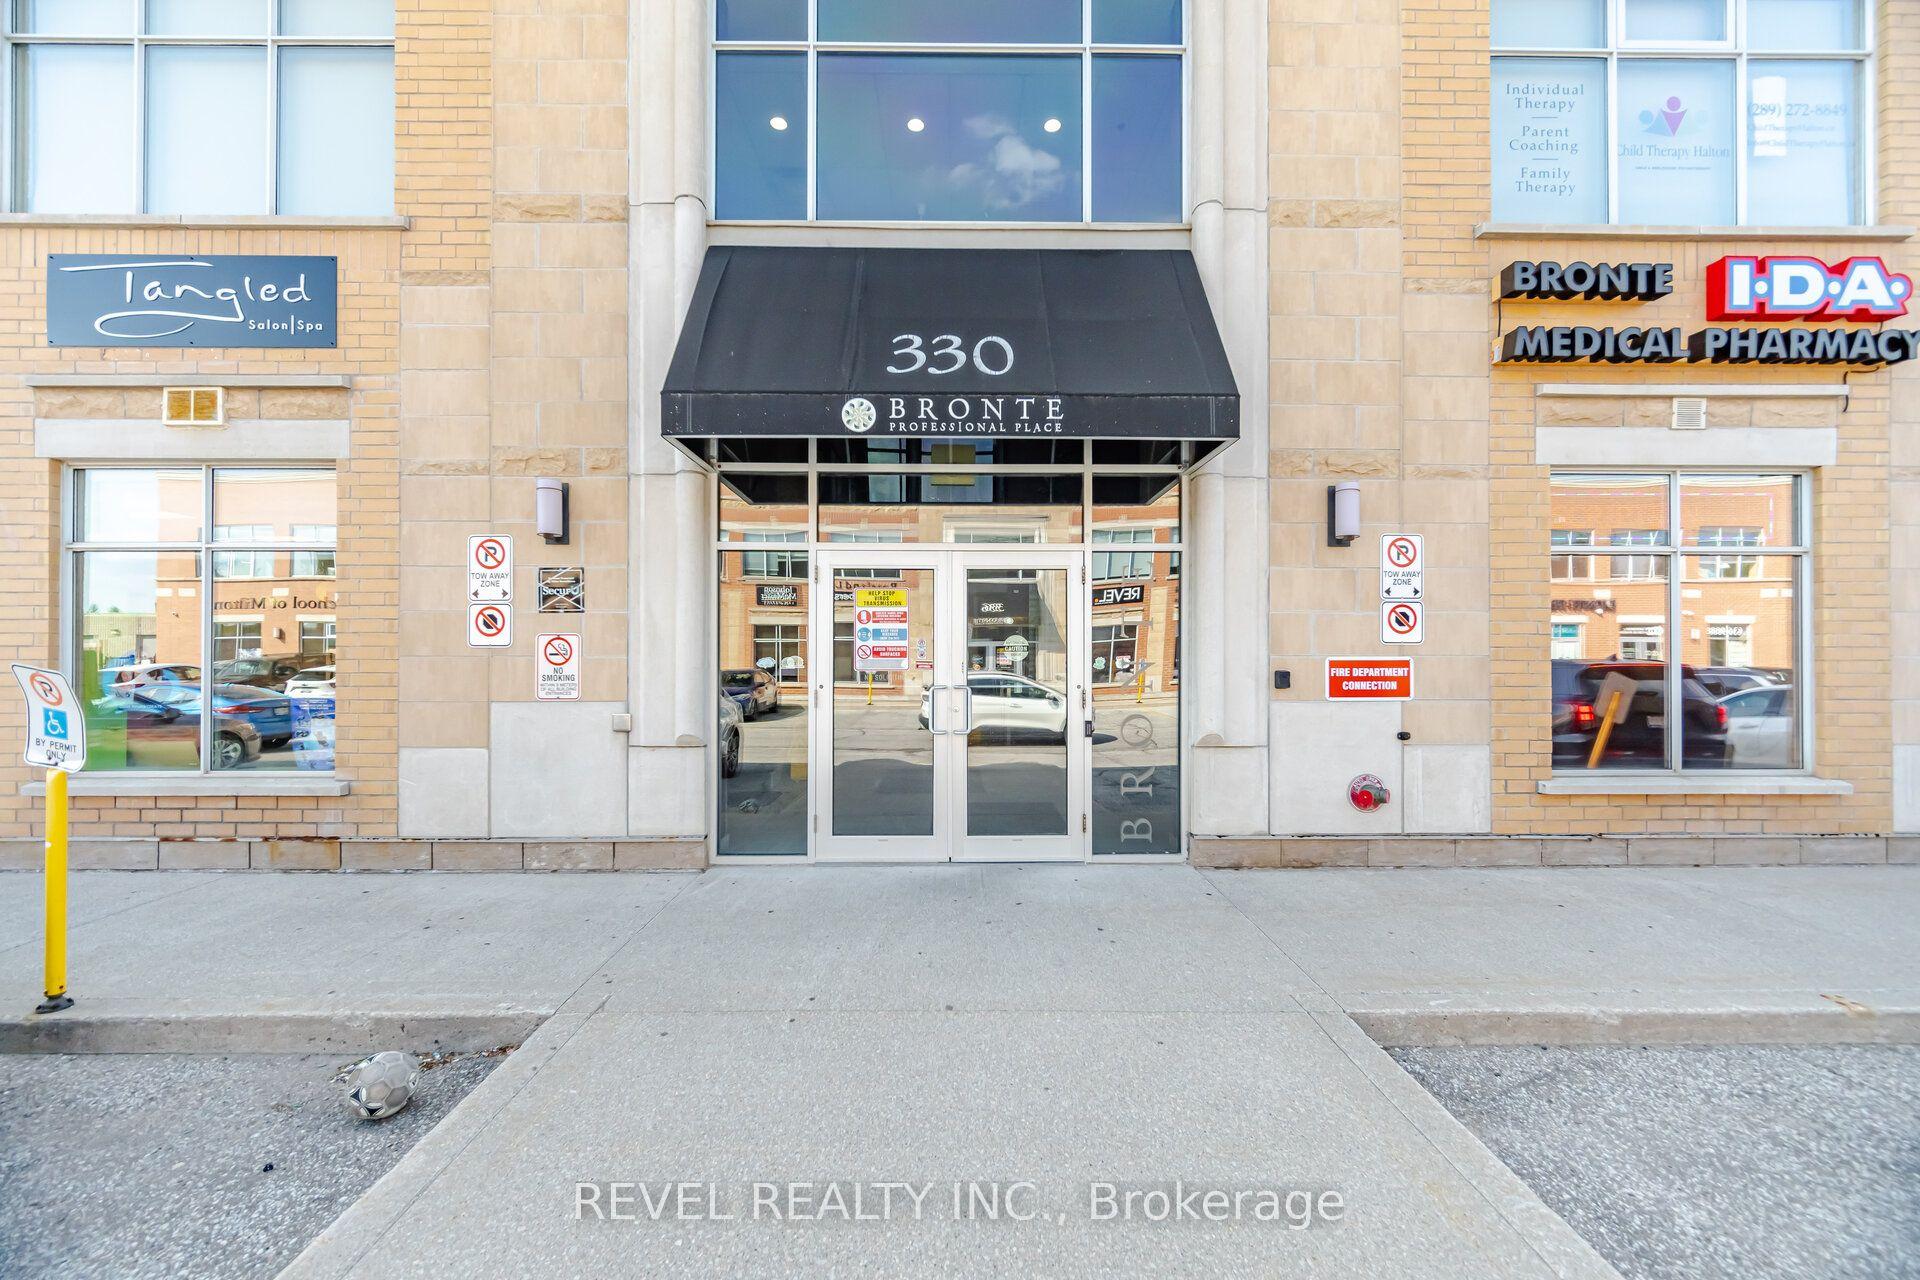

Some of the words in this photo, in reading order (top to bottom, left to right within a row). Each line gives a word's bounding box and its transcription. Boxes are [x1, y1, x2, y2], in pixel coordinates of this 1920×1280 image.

[1506, 83, 1584, 95] Individual
[1515, 97, 1575, 112] Therapy
[1522, 125, 1569, 137] Parent
[1509, 139, 1578, 154] Coaching
[1617, 143, 1643, 157] Child
[1646, 143, 1690, 160] Therapy
[1694, 145, 1730, 158] Halton
[1521, 167, 1570, 182] Family
[1515, 181, 1576, 196] Therapy
[1511, 261, 1674, 294] BRONTE
[58, 261, 313, 338] Tangled
[1512, 326, 1691, 359] MEDICAL
[1704, 328, 1920, 361] PHARMACY
[886, 334, 1015, 376] 330
[889, 397, 1065, 421] BRONTE
[889, 422, 1007, 432] PROFESSIONAL
[1014, 422, 1063, 433] PLACE
[471, 572, 488, 580] TOW
[489, 572, 510, 580] AWAY
[1384, 570, 1400, 578] TOW
[1400, 570, 1421, 578] AWAY
[480, 580, 501, 588] ZONE
[1392, 578, 1412, 586] ZONE
[1330, 667, 1351, 677] FIRE
[1352, 667, 1409, 677] DEPARTMENT
[1342, 681, 1398, 690] CONNECTION
[35, 738, 46, 747] BY
[49, 740, 77, 753] PERMIT
[45, 749, 67, 762] ONLY
